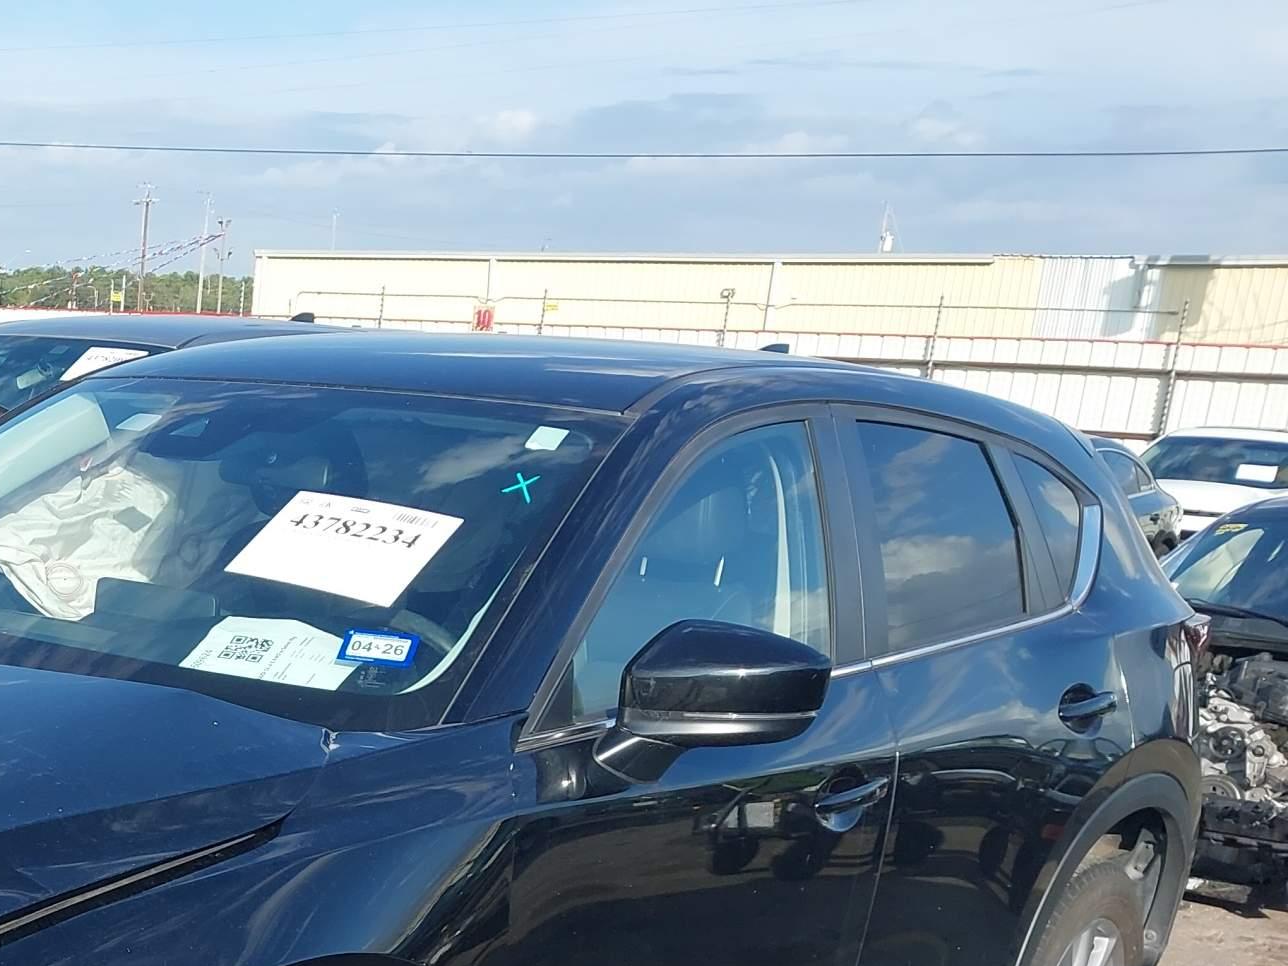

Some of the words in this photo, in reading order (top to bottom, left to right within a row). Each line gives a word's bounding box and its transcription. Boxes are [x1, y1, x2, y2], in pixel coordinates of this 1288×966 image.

[290, 513, 421, 548] 43782234
[352, 640, 373, 652] 04
[381, 643, 405, 656] 26
